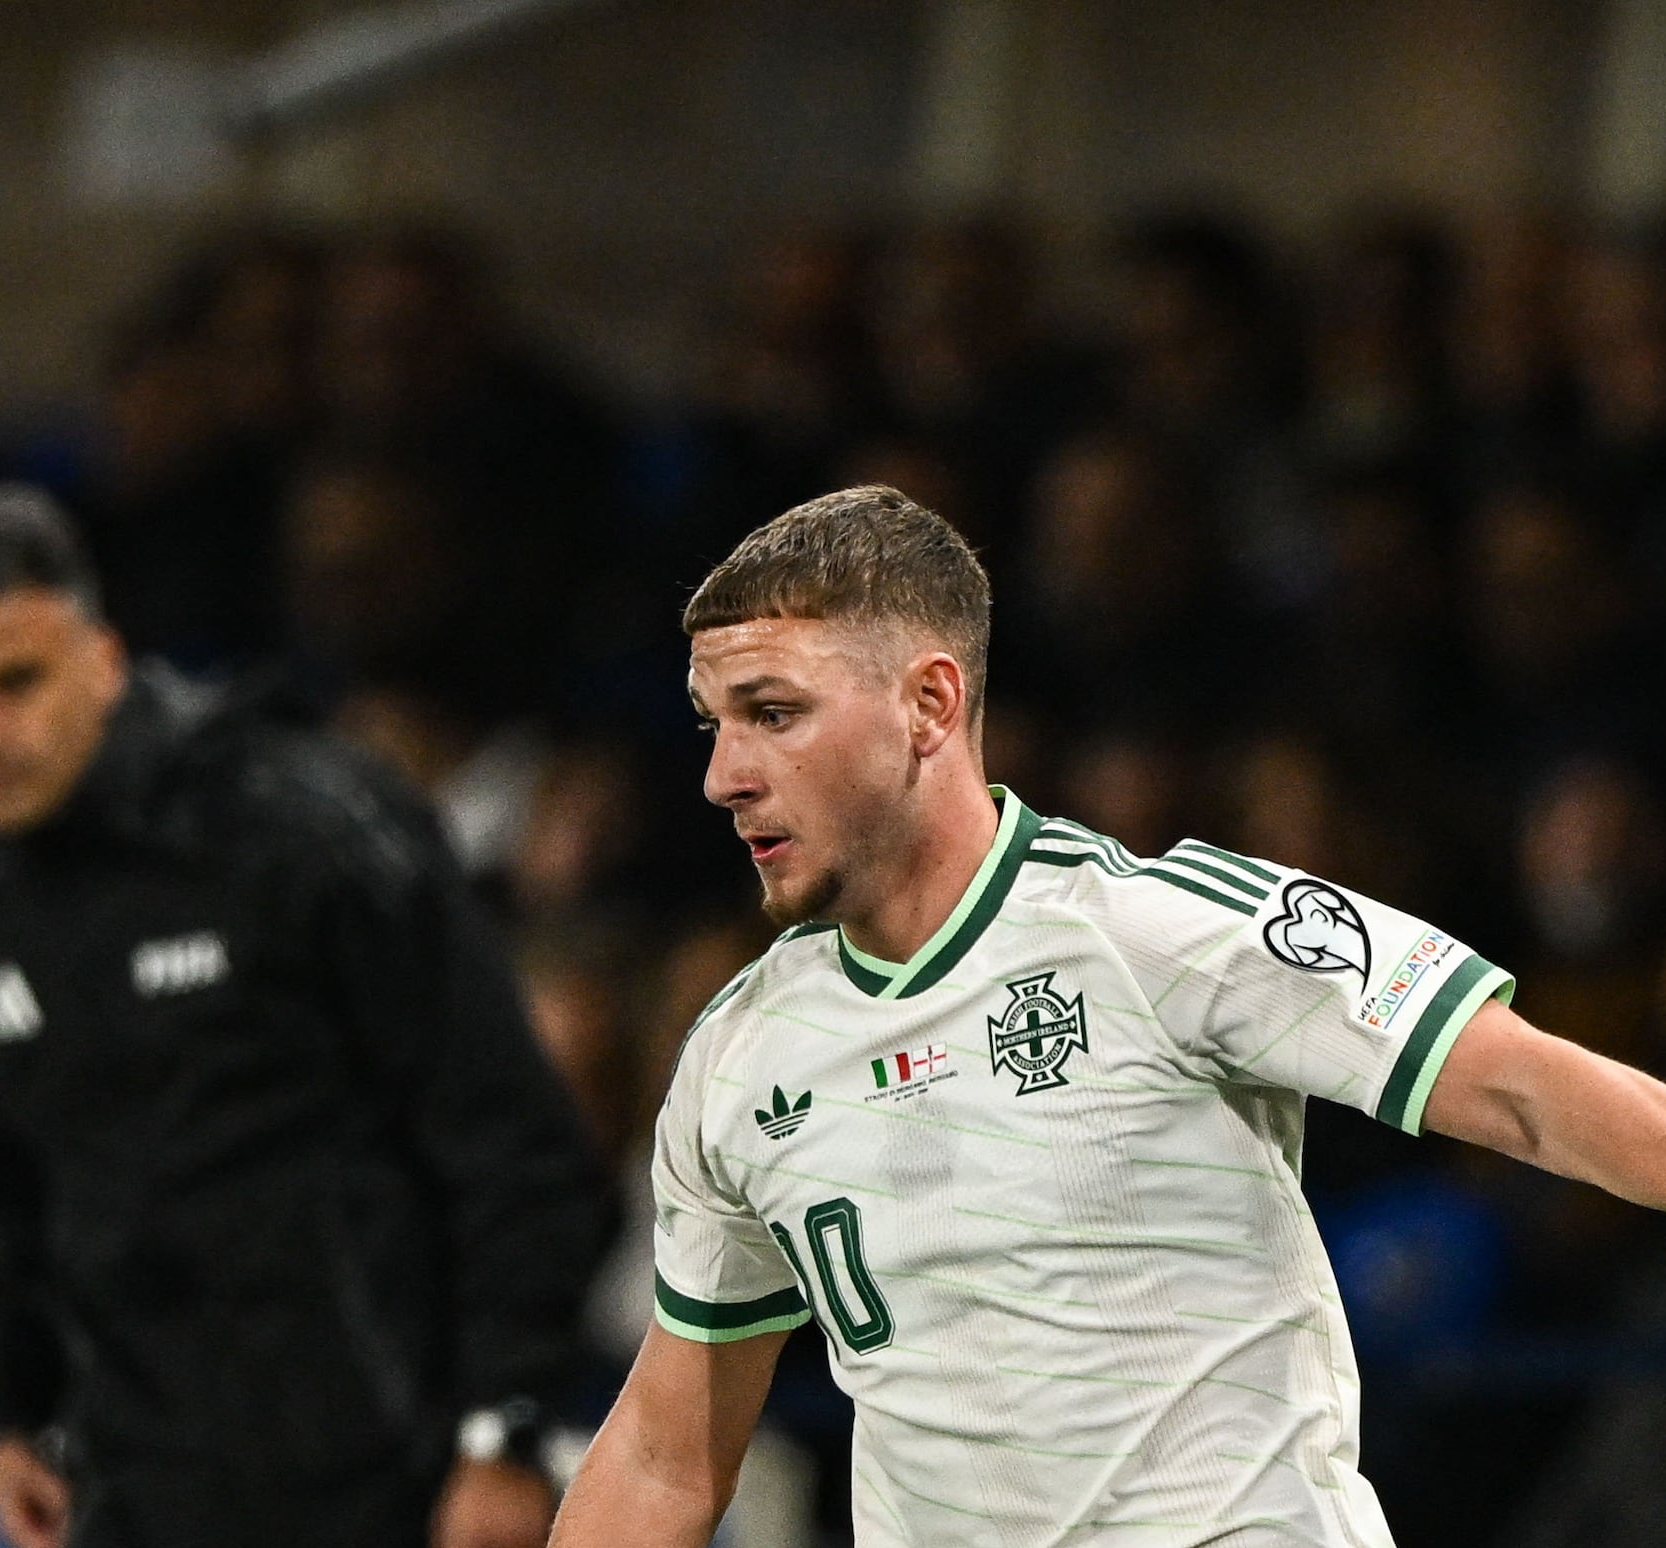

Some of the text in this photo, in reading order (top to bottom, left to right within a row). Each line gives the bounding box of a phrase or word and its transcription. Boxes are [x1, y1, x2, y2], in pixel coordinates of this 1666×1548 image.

[1358, 997, 1377, 1021] UEFA
[1037, 1022, 1069, 1037] IRELAND
[1013, 1043, 1062, 1070] ASSOCIATION
